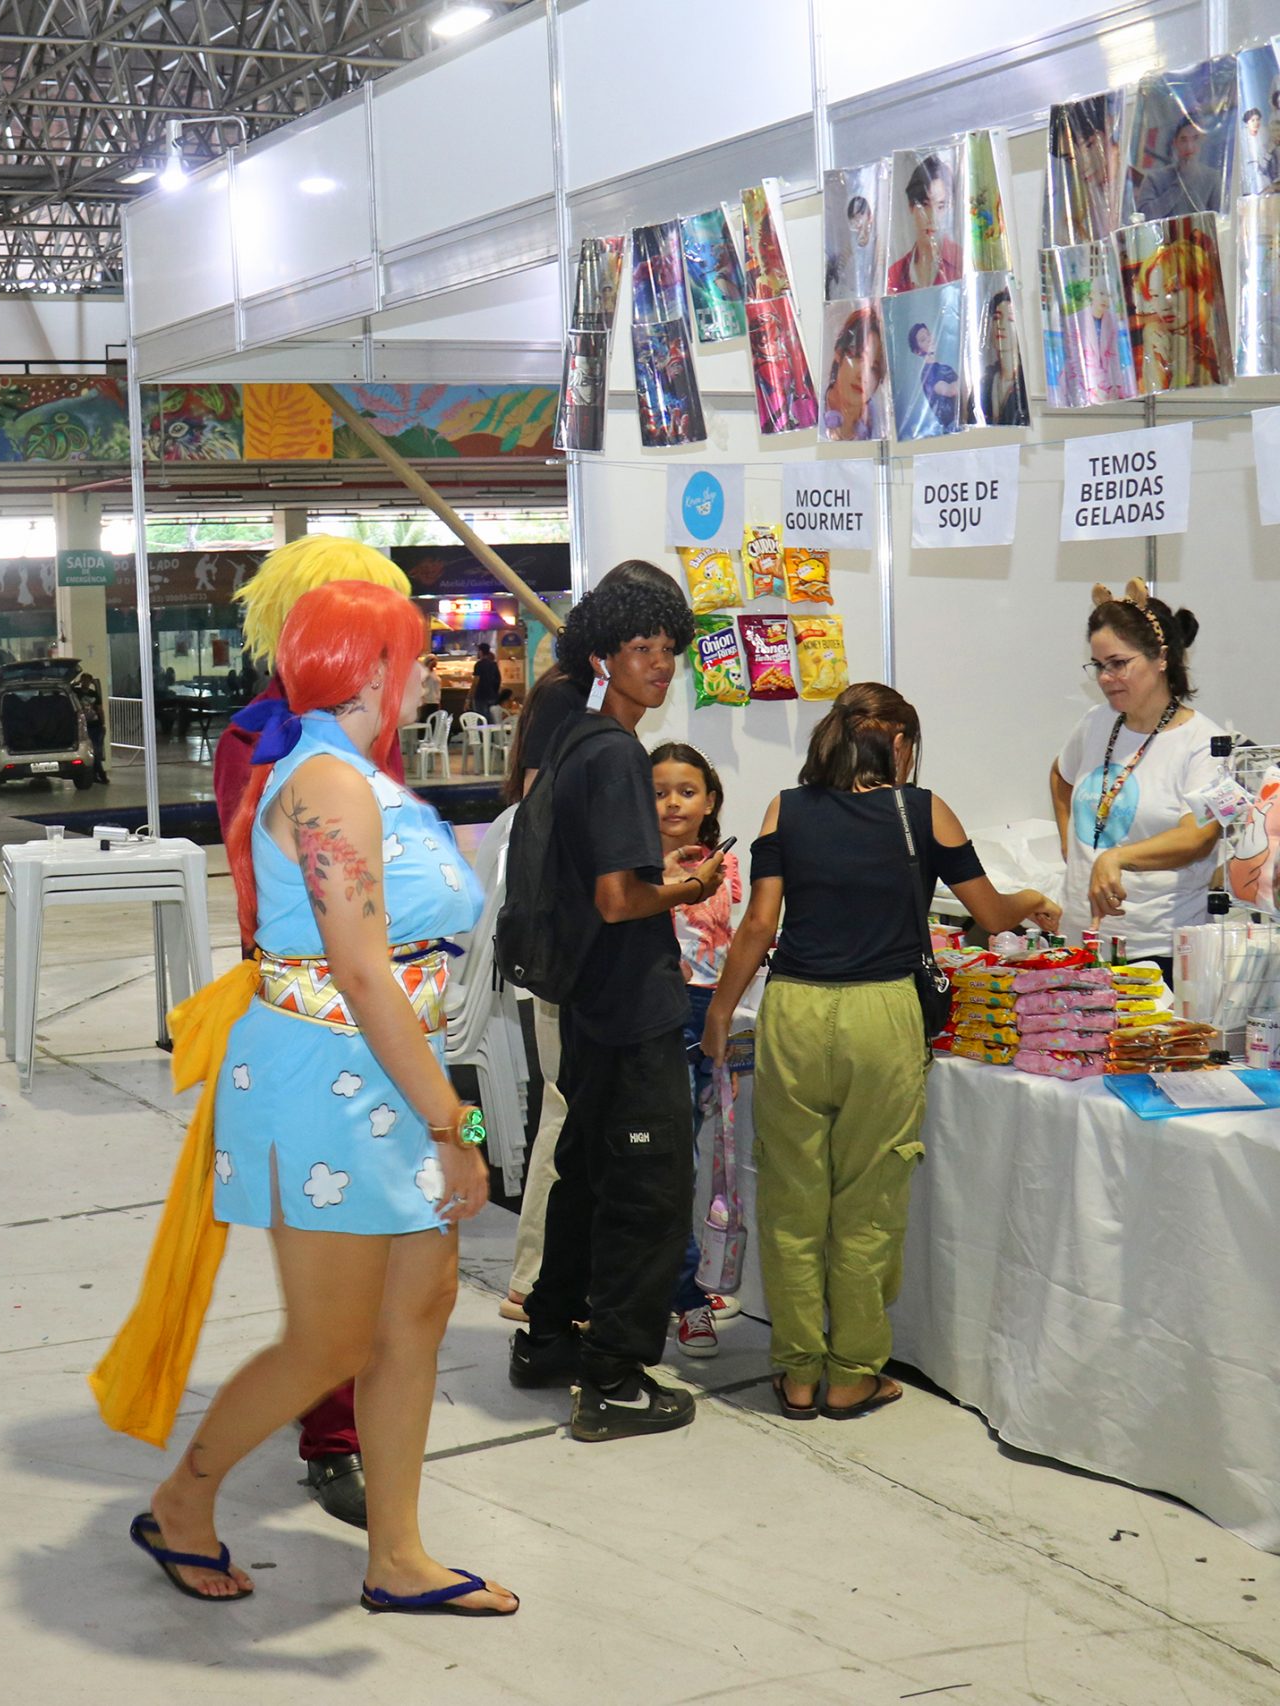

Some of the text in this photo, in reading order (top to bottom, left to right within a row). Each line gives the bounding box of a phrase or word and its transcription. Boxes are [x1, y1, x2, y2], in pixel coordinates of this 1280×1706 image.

[1088, 450, 1157, 477] TEMOS
[796, 488, 851, 508] MOCHI
[924, 479, 999, 504] DOSE DE
[1080, 475, 1164, 503] BEBIDAS
[785, 511, 864, 531] GOURMET
[938, 506, 982, 533] SOJU
[1075, 500, 1165, 527] GELADAS
[66, 553, 106, 569] SAÍDA
[701, 633, 735, 655] Onion
[629, 1132, 650, 1144] HIGH
